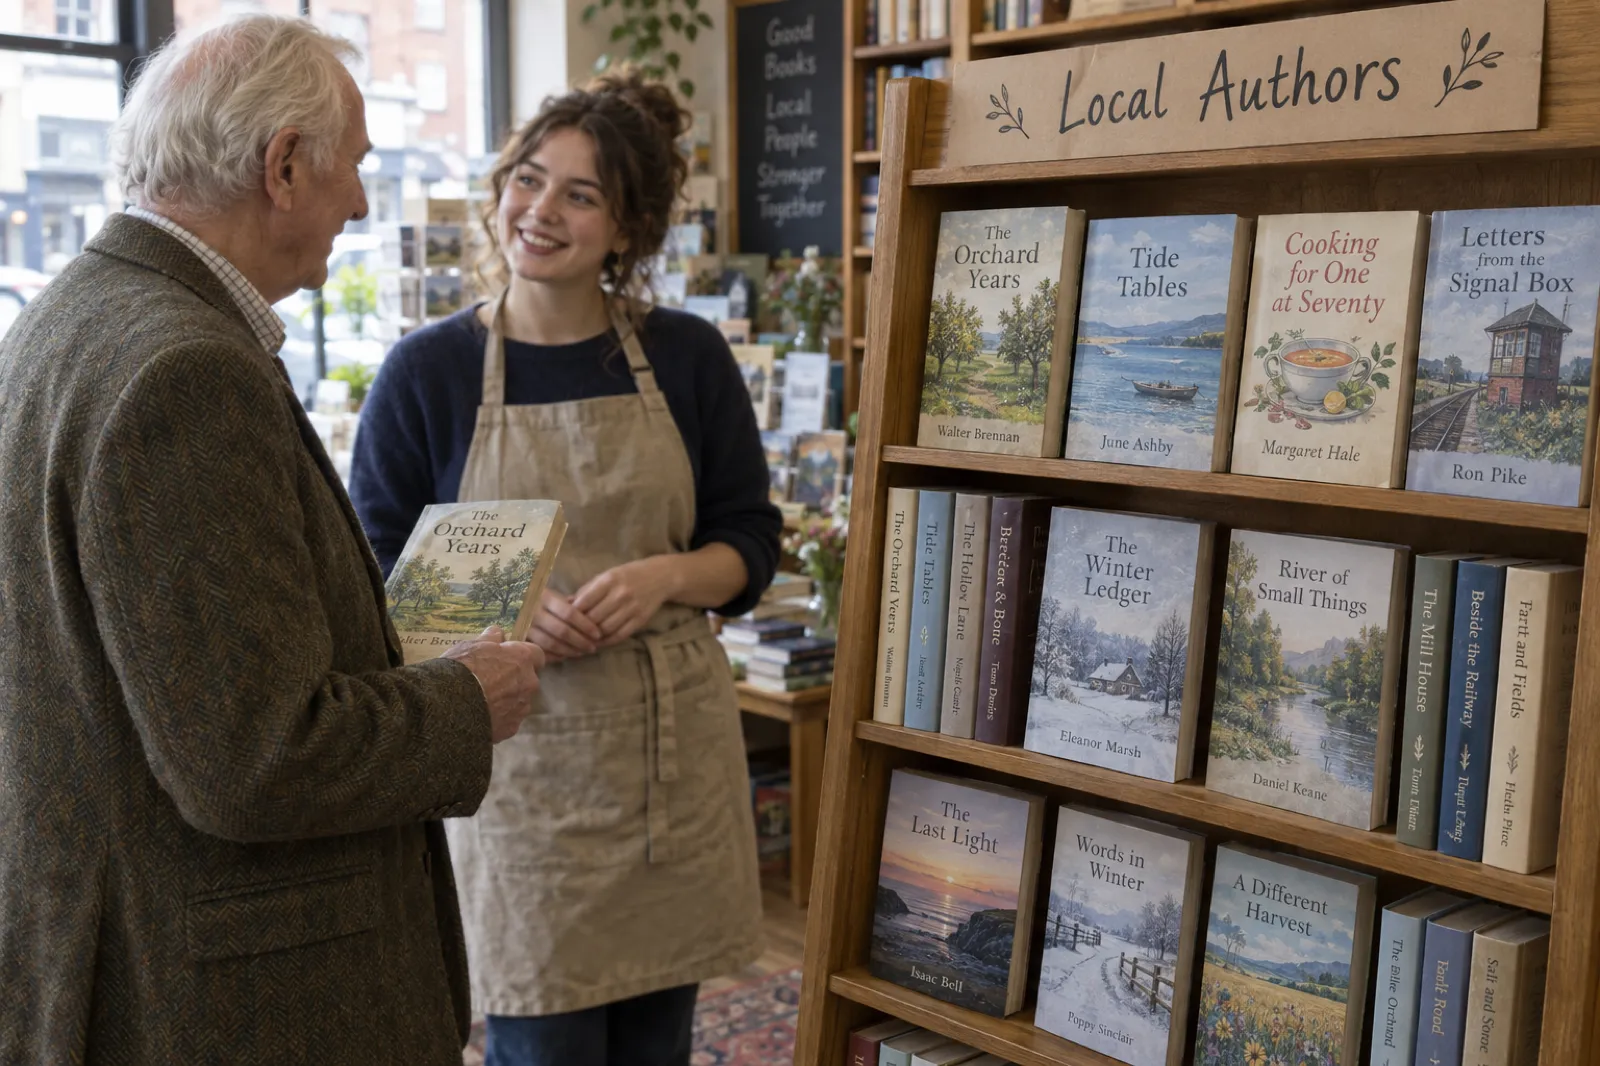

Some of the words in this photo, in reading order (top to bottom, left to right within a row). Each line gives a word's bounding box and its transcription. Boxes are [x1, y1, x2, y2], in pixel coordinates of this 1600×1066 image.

[765, 14, 815, 47] Good
[764, 49, 817, 80] Books
[765, 89, 813, 120] Local
[1058, 61, 1169, 135] Local
[1199, 47, 1402, 122] Authors
[765, 124, 818, 157] People
[983, 225, 1012, 241] The
[1285, 230, 1380, 261] Cooking
[1460, 226, 1546, 248] Letters
[953, 241, 1041, 266] Orchard
[1129, 246, 1180, 269] Tide
[1477, 252, 1515, 270] from
[1520, 252, 1546, 267] the
[967, 268, 1021, 291] Years
[1116, 275, 1189, 299] Tables
[1284, 260, 1318, 292] for
[1322, 261, 1371, 286] One
[1449, 271, 1520, 300] Signal
[1527, 271, 1575, 294] Box
[1271, 296, 1293, 315] at
[1298, 290, 1387, 324] Seventy
[936, 425, 971, 442] Walter
[973, 427, 1021, 444] Brennan
[1099, 434, 1128, 453] June
[1131, 436, 1175, 457] Ashby
[1261, 440, 1324, 463] Margaret
[1327, 445, 1362, 463] Hale
[1452, 463, 1485, 483] Ron
[1490, 467, 1528, 486] Pike
[433, 522, 527, 539] Orchard
[471, 510, 499, 522] The
[445, 538, 503, 555] Years
[924, 522, 939, 556] Tide
[963, 522, 977, 549] The
[1105, 534, 1139, 556] The
[921, 558, 935, 606] Tables
[1084, 553, 1155, 582] Winter
[1278, 558, 1328, 584] River
[1332, 568, 1351, 586] of
[1083, 576, 1153, 609] Ledger
[1257, 582, 1304, 606] Small
[1308, 588, 1368, 619] Things
[1422, 588, 1439, 619] The
[1468, 589, 1486, 639] Beside
[1418, 622, 1437, 659] Mill
[1466, 641, 1483, 667] the
[1514, 641, 1529, 670] and
[1415, 660, 1434, 714] House
[1461, 669, 1480, 729] Railway
[1510, 673, 1528, 720] Fields
[1059, 730, 1103, 751] Eleanor
[1104, 738, 1143, 759] Marsh
[1252, 771, 1290, 793] Daniel
[1292, 781, 1329, 802] Keane
[940, 800, 971, 823] The
[910, 814, 947, 842] Last
[951, 825, 1000, 856] Light
[1075, 833, 1125, 863] Words
[1128, 850, 1146, 870] in
[1088, 860, 1146, 892] Winter
[1232, 873, 1246, 893] A
[1250, 877, 1329, 917] Different
[1245, 901, 1313, 938] Harvest
[910, 964, 938, 985] Isaac
[941, 974, 965, 993] Bell
[1067, 1010, 1097, 1034] Poppy
[1097, 1022, 1135, 1046] Sinclair
